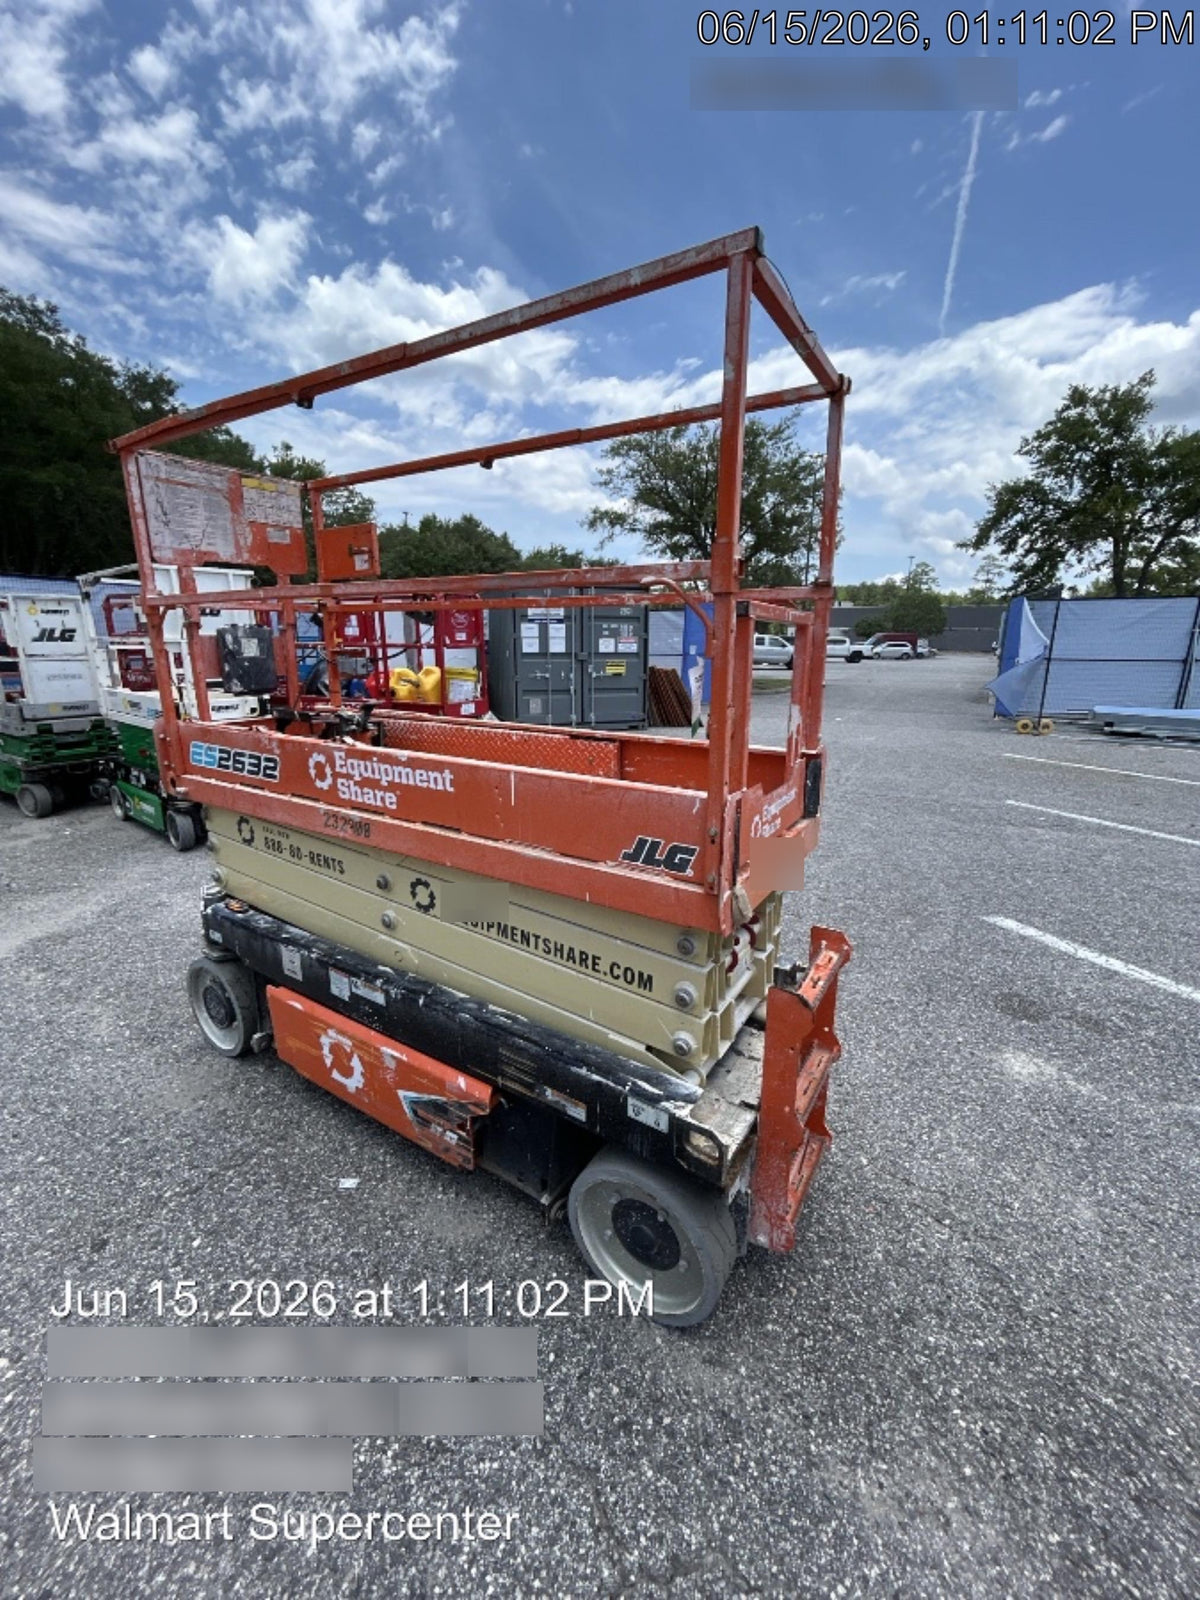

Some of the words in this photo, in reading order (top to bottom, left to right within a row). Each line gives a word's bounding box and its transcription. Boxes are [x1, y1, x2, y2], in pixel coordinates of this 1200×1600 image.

[32, 628, 77, 642] JLG
[190, 741, 280, 782] ES2632
[334, 751, 454, 792] Equipment
[337, 778, 398, 809] Share
[619, 835, 699, 875] JLG
[461, 921, 654, 993] IPMENTSHARE.COM
